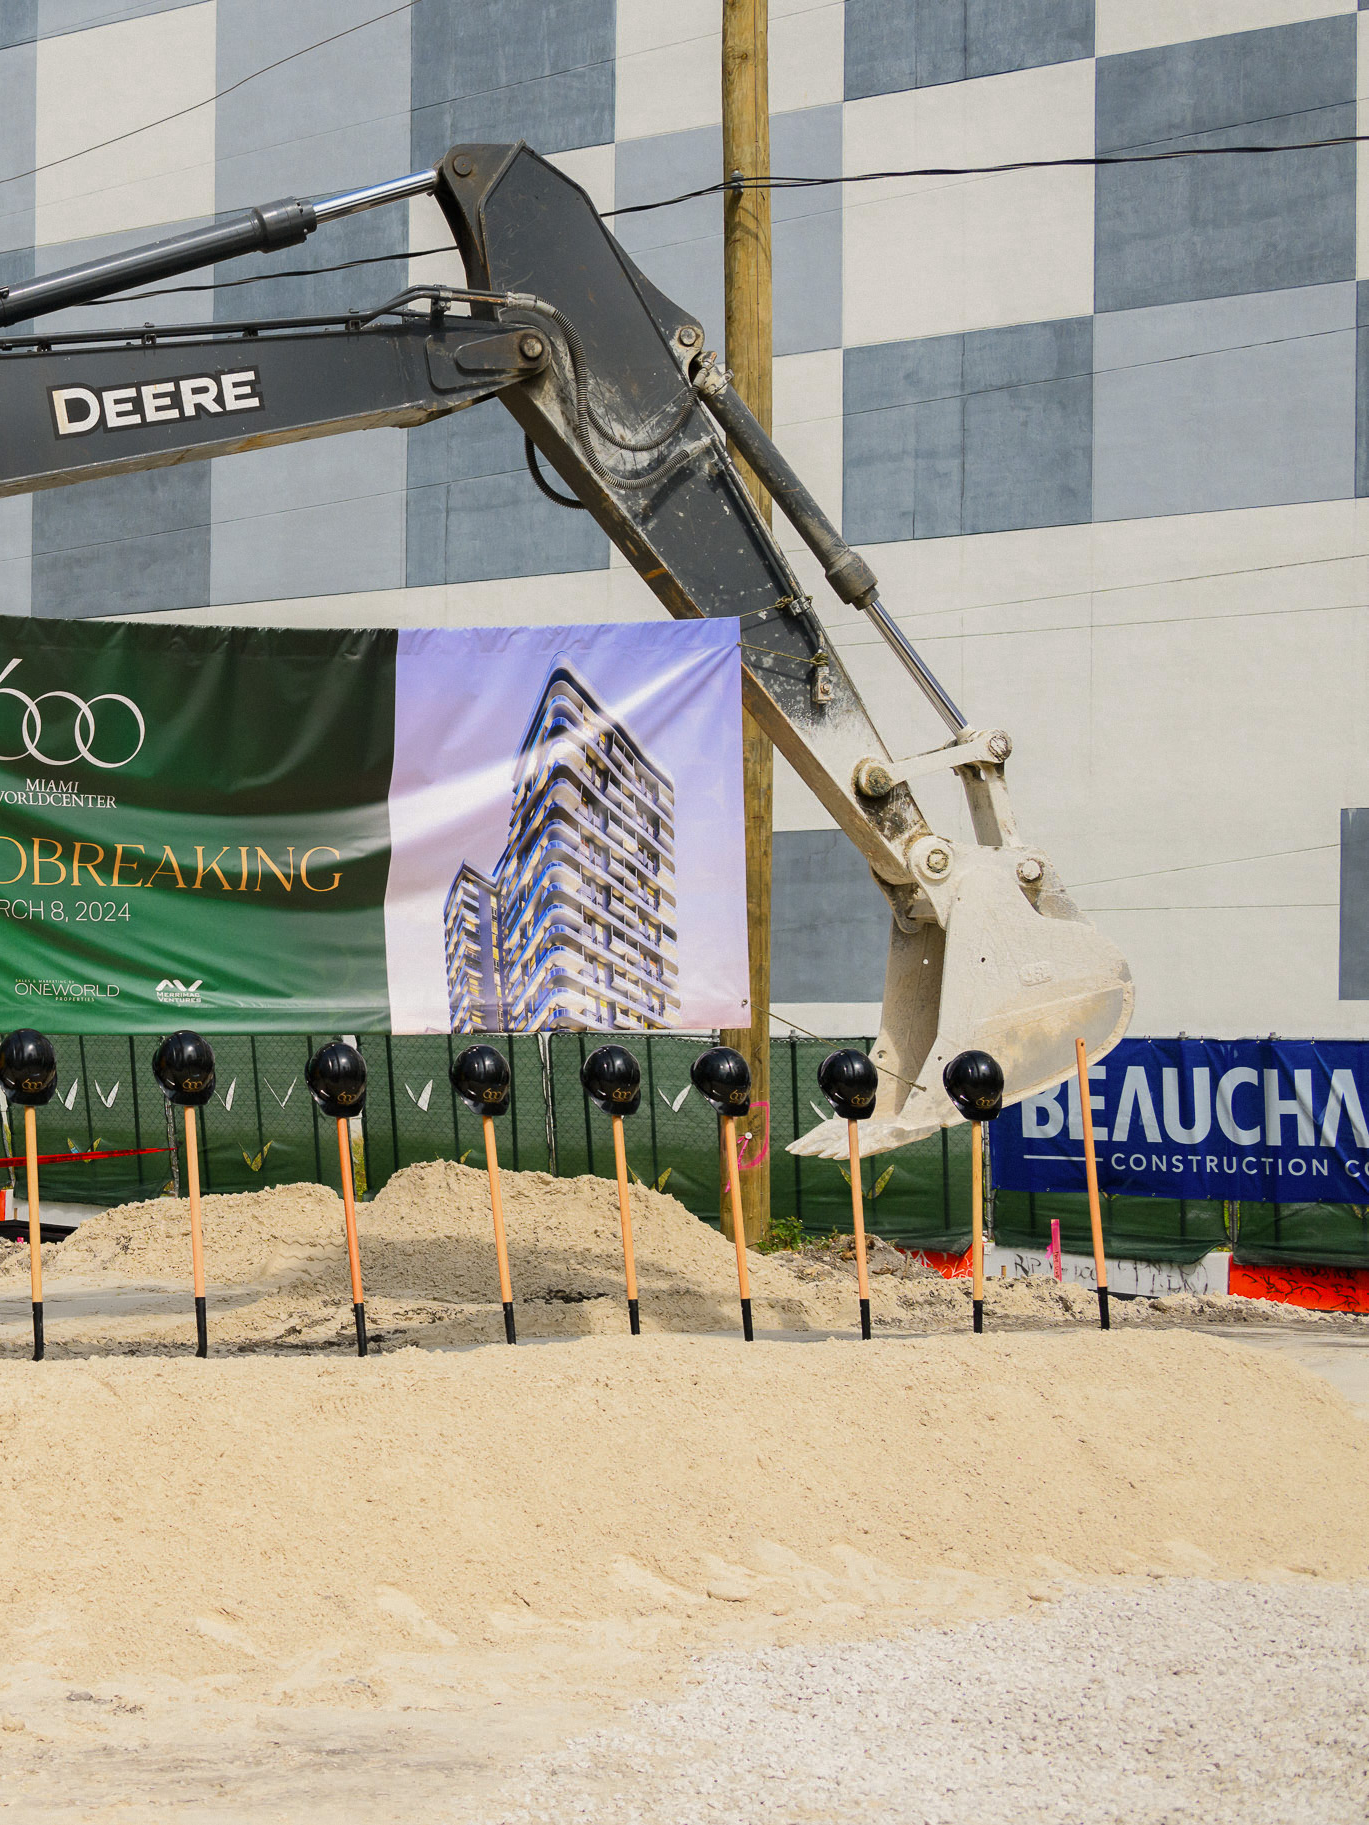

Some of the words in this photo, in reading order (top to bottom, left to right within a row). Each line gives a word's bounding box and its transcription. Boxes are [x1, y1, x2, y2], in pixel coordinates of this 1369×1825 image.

[51, 370, 261, 435] DEERE
[25, 778, 79, 793] MIAMI
[50, 902, 70, 924] 8,
[75, 901, 132, 923] 2024
[14, 982, 120, 998] ONEWORLD
[1111, 1153, 1329, 1177] CONSTRUCTION
